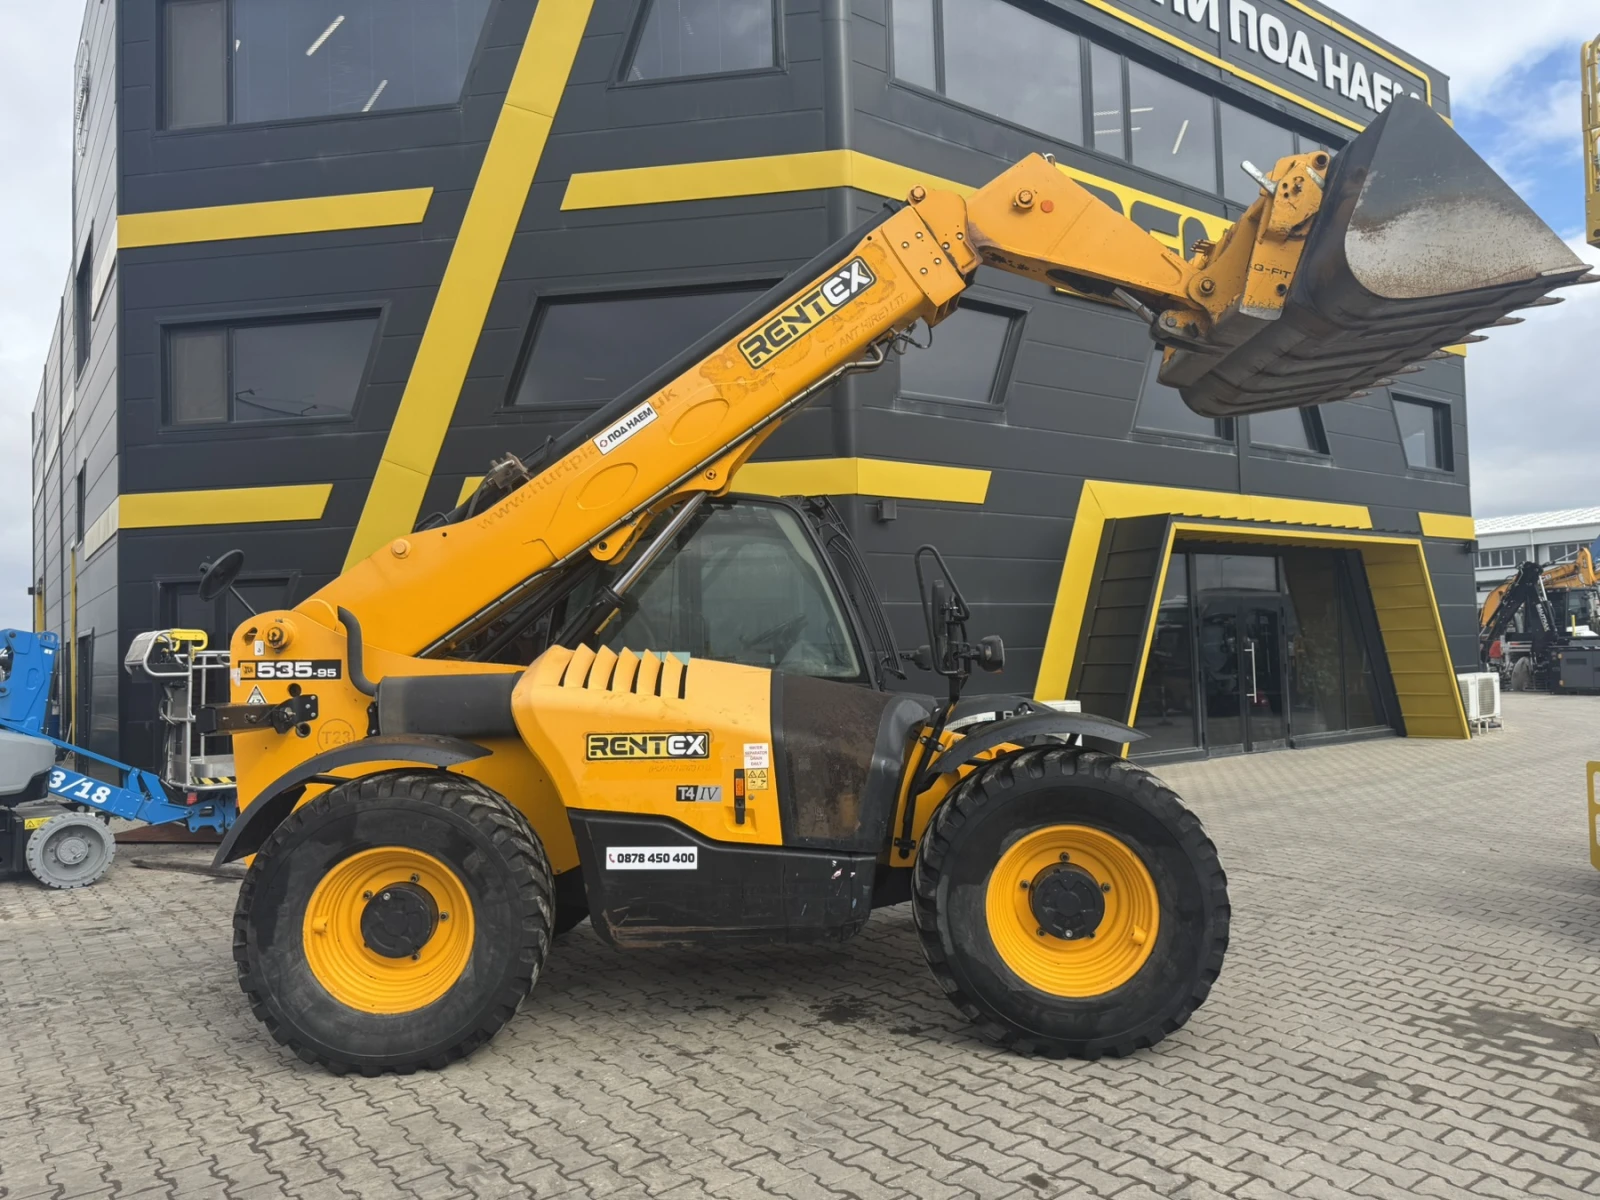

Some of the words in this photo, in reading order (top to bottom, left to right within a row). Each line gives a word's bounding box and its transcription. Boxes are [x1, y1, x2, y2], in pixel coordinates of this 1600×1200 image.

[1229, 0, 1318, 82] ПОД
[1324, 44, 1421, 114] НАЕ
[1254, 263, 1292, 279] Q-FIT
[742, 261, 871, 365] RENTEX
[607, 426, 629, 443] ПОД
[626, 407, 654, 430] НАЕМ
[257, 661, 337, 679] 535-95
[321, 731, 351, 745] T23
[590, 735, 705, 756] RENTEX
[49, 770, 112, 804] 3/18
[617, 853, 645, 864] 0878
[647, 853, 670, 864] 450
[672, 853, 695, 864] 400
